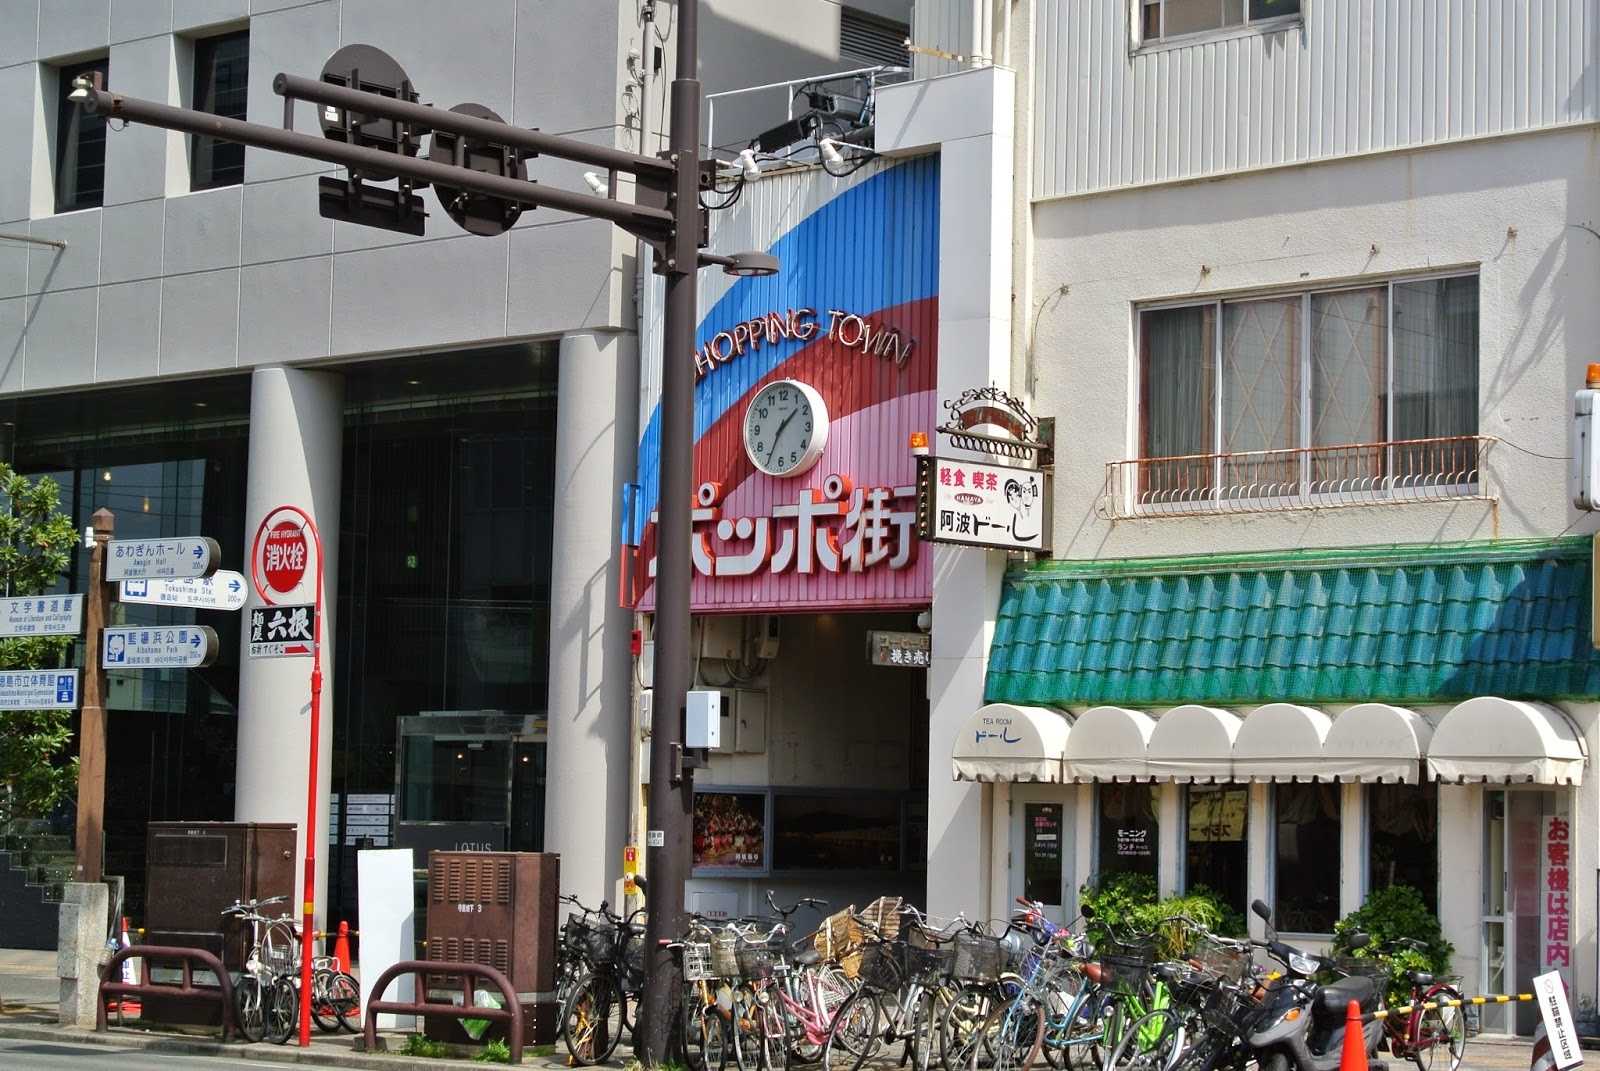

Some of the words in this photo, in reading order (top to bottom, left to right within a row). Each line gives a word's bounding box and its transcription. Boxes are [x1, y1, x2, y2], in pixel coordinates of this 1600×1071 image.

[695, 308, 817, 379] HOPPING
[828, 309, 916, 367] TOWN
[768, 395, 776, 406] 11
[779, 390, 788, 400] 12
[759, 408, 768, 418] 10
[802, 405, 808, 416] 2
[754, 425, 760, 436] 9
[805, 422, 811, 432] 3
[757, 442, 764, 452] 8
[800, 440, 806, 450] 4
[778, 457, 784, 467] 6
[790, 452, 797, 462] 5
[940, 466, 966, 488] 軽食
[972, 470, 998, 491] 喫茶
[940, 509, 1039, 542] 阿波ドール
[115, 543, 186, 557] あわぎんホール
[266, 542, 305, 571] 消火栓
[976, 727, 1023, 743] ドール
[1547, 817, 1569, 996] お客様は店内
